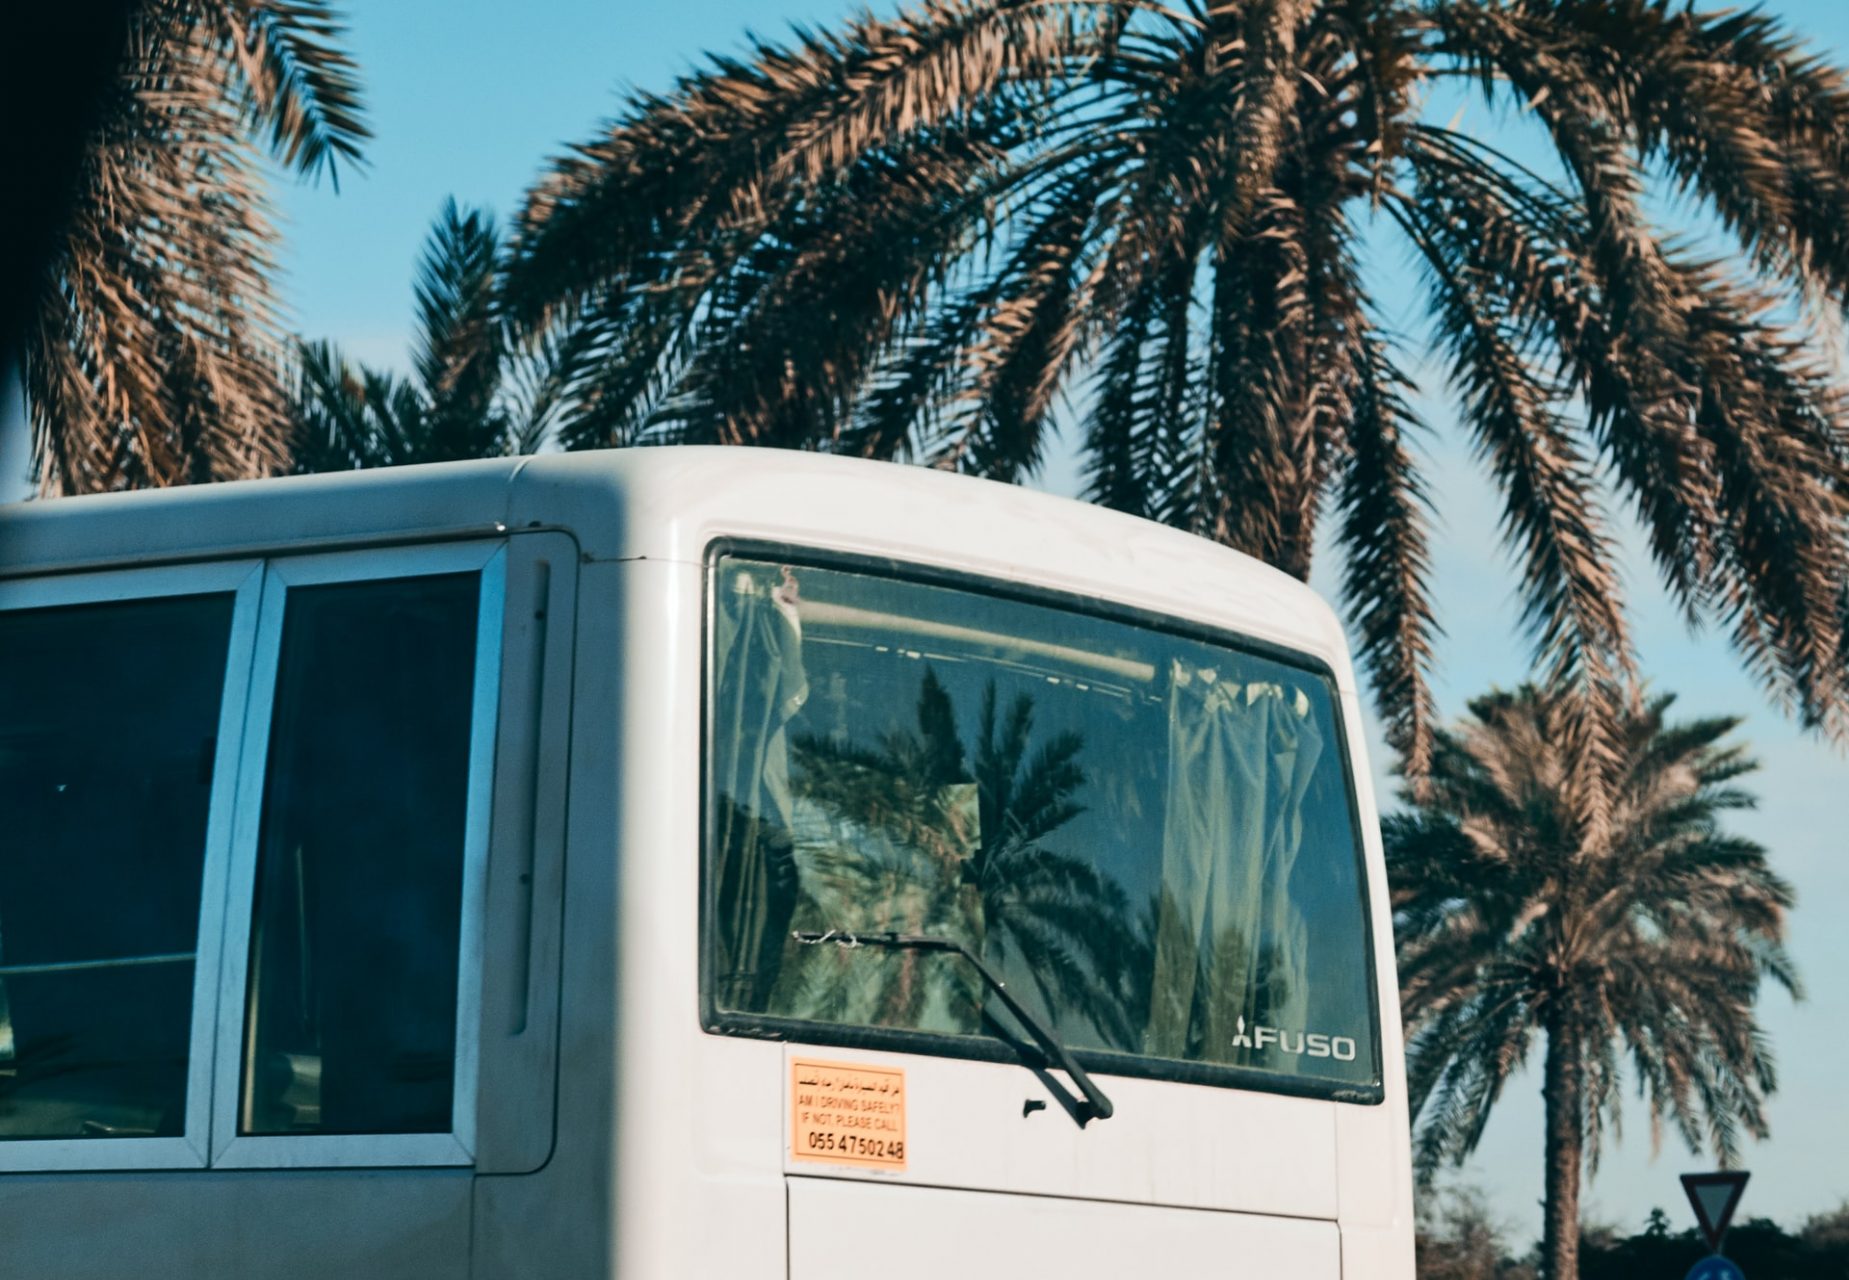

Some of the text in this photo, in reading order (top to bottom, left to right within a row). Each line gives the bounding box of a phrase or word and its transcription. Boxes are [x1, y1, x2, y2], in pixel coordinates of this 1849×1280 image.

[1254, 1025, 1356, 1061] FUSO
[799, 1095, 813, 1107] AM
[821, 1096, 858, 1111] DRIVING
[801, 1112, 810, 1123] IF
[836, 1114, 872, 1129] PLEASE
[874, 1118, 898, 1132] CALL
